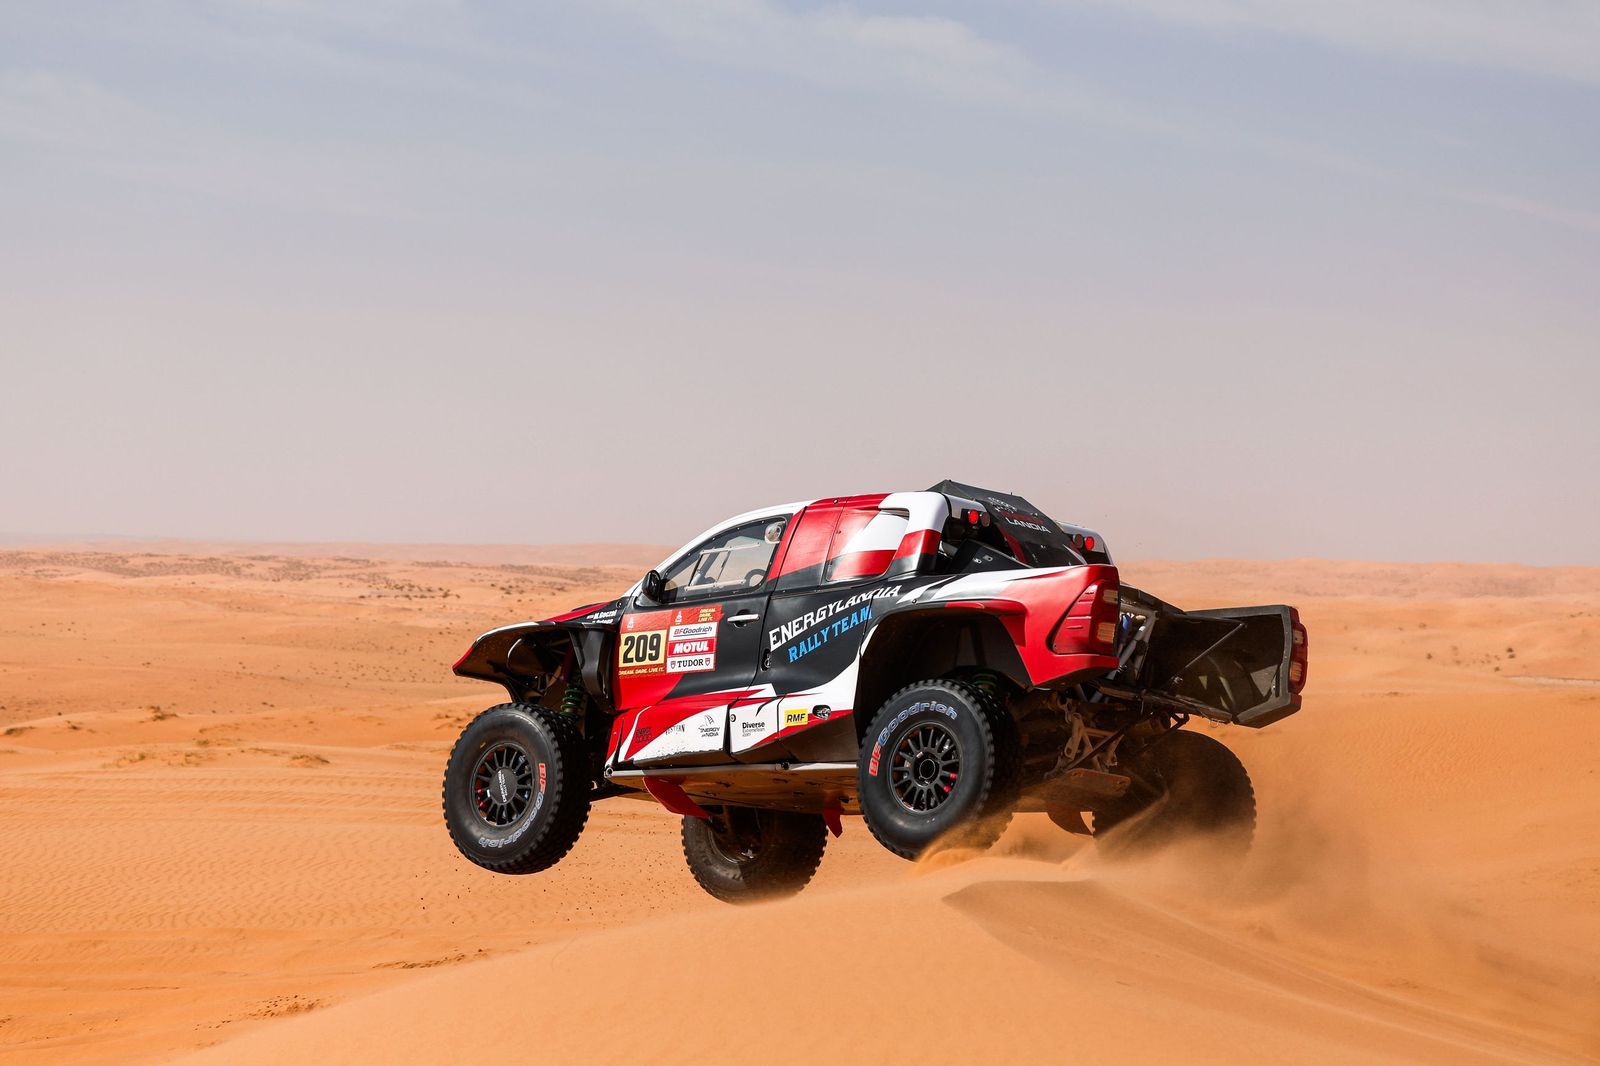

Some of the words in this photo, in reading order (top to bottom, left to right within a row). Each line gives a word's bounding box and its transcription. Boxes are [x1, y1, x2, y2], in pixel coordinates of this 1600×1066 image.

[1005, 517, 1052, 534] LANDIA
[674, 626, 713, 636] BFGoodrich
[788, 626, 830, 663] RALLY
[832, 606, 872, 638] TEAM
[622, 633, 662, 664] 209
[673, 641, 709, 654] MOTUL
[677, 659, 704, 668] TUDOR
[786, 711, 806, 724] RMF
[868, 700, 958, 777] BFGoodrich
[479, 762, 547, 848] BFGoodrich
